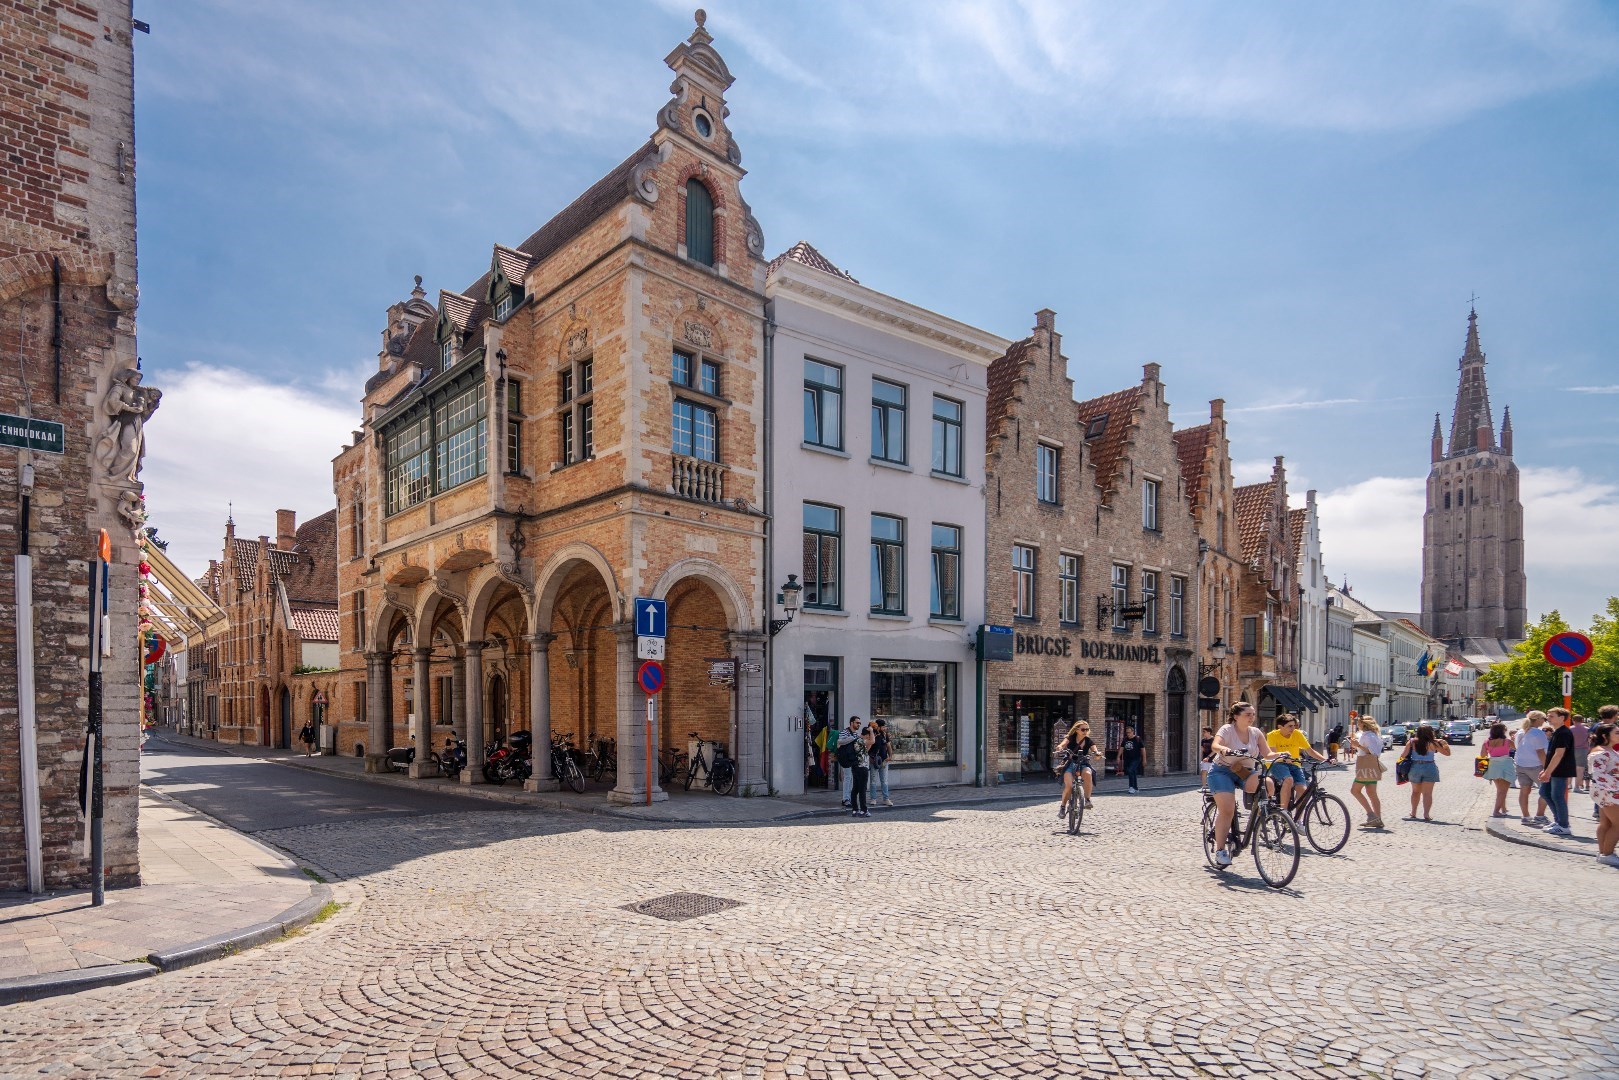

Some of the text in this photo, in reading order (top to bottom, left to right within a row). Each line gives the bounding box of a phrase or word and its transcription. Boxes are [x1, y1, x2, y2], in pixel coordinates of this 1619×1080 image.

[0, 425, 56, 442] ENHODKAAI
[1016, 632, 1161, 664] BRUGSE BOEKHANDEL
[1074, 666, 1115, 676] De Meester
